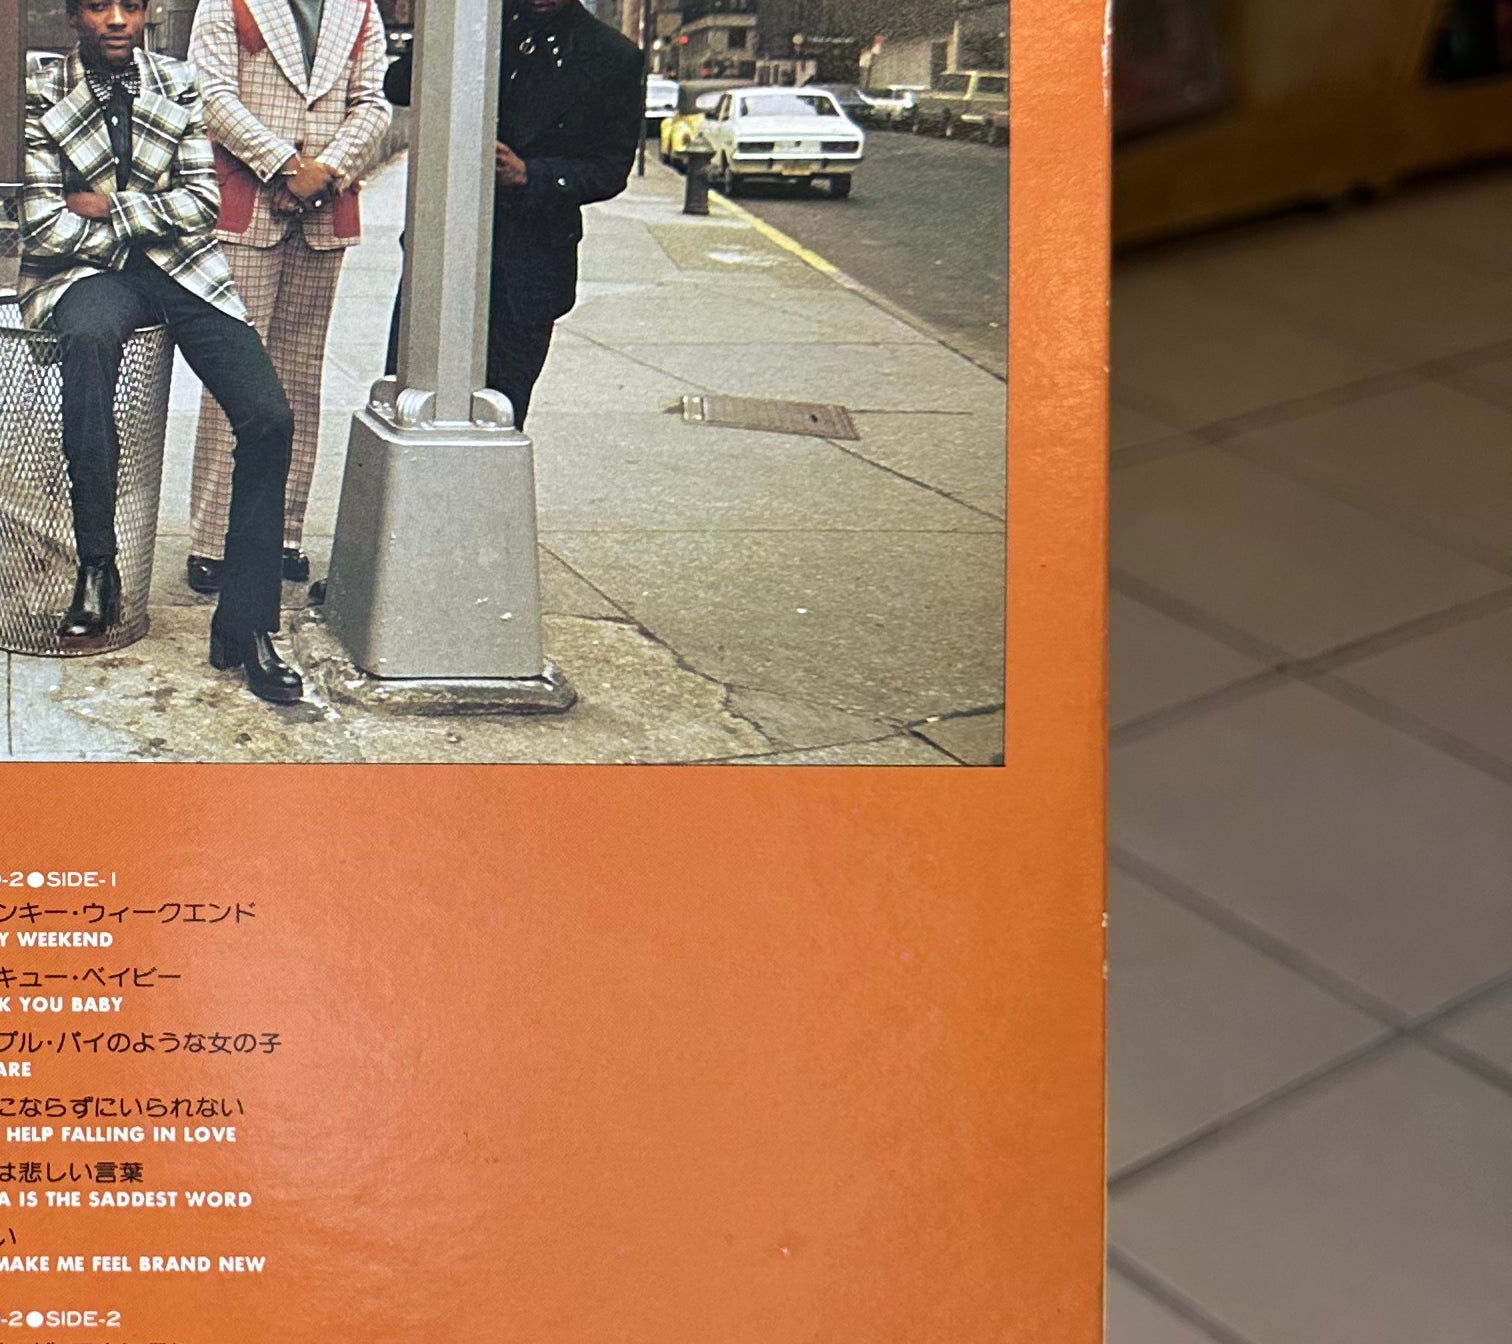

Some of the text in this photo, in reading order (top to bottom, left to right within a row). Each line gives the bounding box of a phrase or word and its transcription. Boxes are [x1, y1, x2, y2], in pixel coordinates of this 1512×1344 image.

[17, 932, 112, 947] WEEKEND
[20, 997, 62, 1012] YOU
[72, 997, 122, 1012] BABY
[7, 1127, 53, 1142] HELP
[62, 1126, 144, 1142] FALLING
[154, 1127, 175, 1141] IN
[184, 1127, 235, 1142] LOVE
[20, 1191, 37, 1207] IS
[46, 1192, 80, 1206] THE
[90, 1192, 177, 1207] SADDEST
[185, 1192, 251, 1207] WORD
[57, 1256, 84, 1271] ME
[93, 1256, 131, 1271] FEEL
[140, 1256, 210, 1272] BRAND
[219, 1257, 265, 1272] NEW
